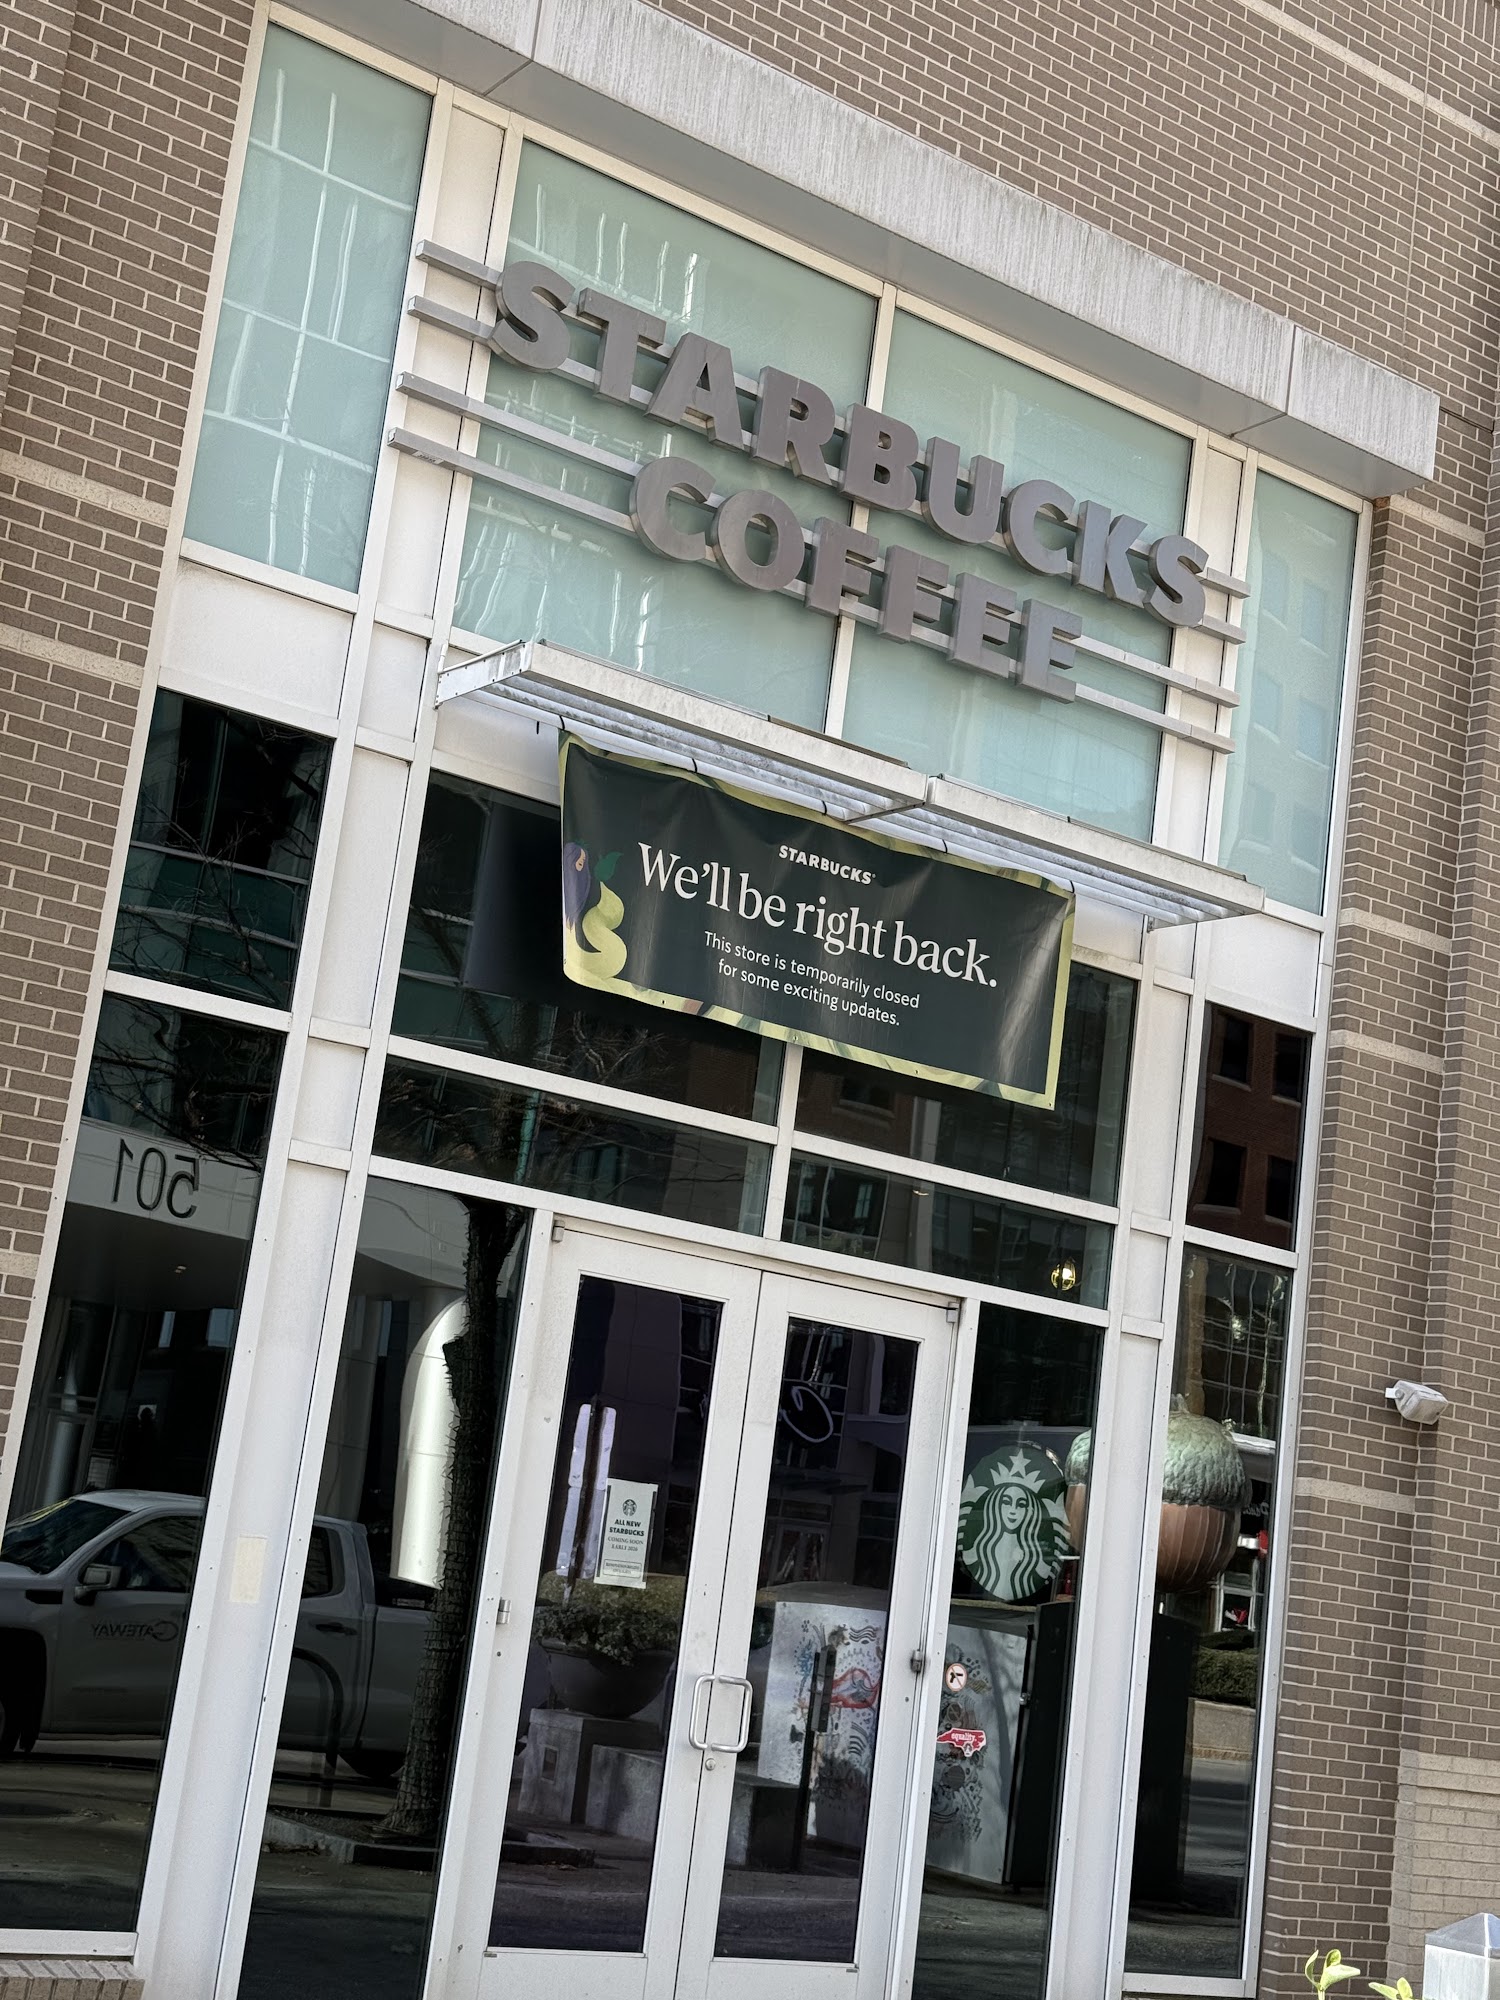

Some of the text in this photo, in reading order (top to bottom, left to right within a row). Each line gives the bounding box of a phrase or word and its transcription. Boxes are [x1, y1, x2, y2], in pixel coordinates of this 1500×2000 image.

[488, 261, 1209, 627] STARBUCKS
[629, 456, 1081, 703] COFFEE
[779, 845, 872, 885] STARBUCKS
[638, 842, 997, 988] We’ll be right back.
[704, 931, 920, 1009] This store is temporarily closed
[718, 959, 900, 1026] for some exciting updates.
[607, 1536, 629, 1544] COMING
[609, 1526, 645, 1537] STARBUCKS
[614, 1518, 642, 1528] ALL NEW
